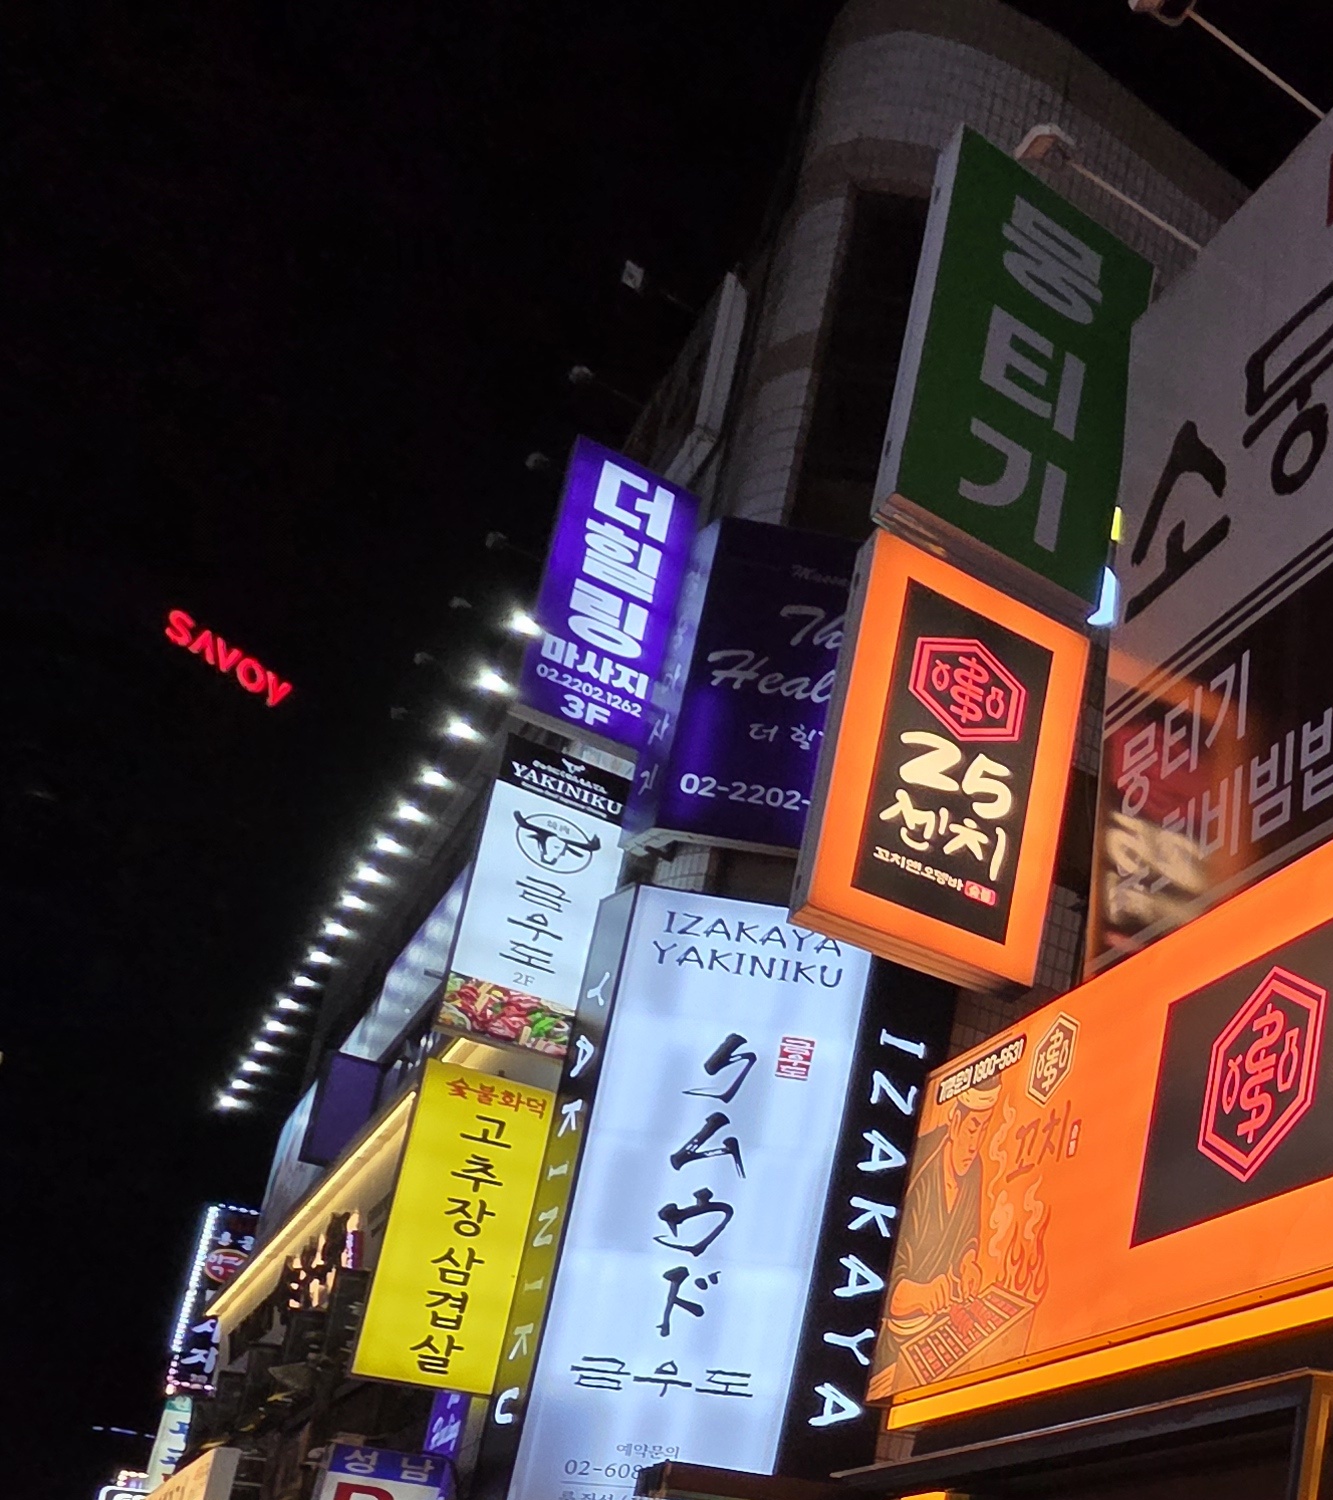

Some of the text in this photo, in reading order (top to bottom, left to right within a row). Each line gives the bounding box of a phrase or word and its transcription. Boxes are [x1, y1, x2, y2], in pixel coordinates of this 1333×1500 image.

[957, 194, 1103, 553] 뭉티기
[780, 604, 847, 650] Th
[164, 609, 294, 708] SAVOY
[541, 632, 650, 699] 마사지
[706, 649, 837, 704] Heal
[560, 694, 612, 726] 3F
[1116, 648, 1250, 818] 뭉티기
[511, 760, 623, 816] YAKINIKU
[899, 731, 1013, 820] 25
[662, 909, 842, 958] IZAKAYA
[512, 971, 536, 987] 2F
[652, 940, 843, 989] YAKINIKU
[408, 1113, 512, 1377] 고추장삼겹살
[807, 1027, 926, 1428] IZAKAYA
[570, 1355, 754, 1400] 금우도
[343, 1449, 435, 1483] 성남
[616, 1443, 680, 1460] 예약문의
